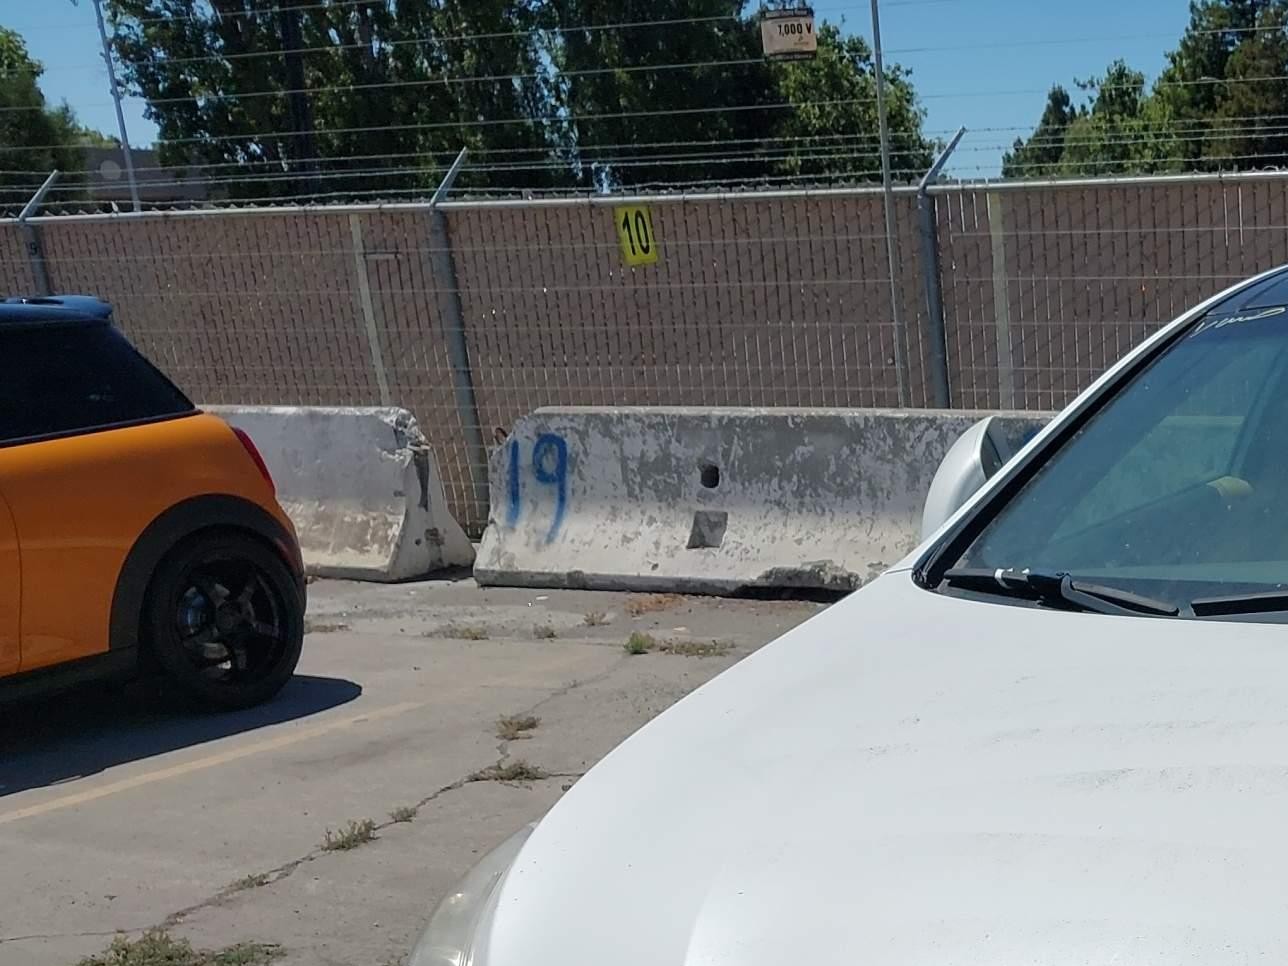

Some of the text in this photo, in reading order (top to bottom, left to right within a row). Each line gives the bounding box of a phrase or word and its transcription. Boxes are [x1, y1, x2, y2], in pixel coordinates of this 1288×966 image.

[805, 23, 812, 34] V
[622, 210, 650, 255] 10
[505, 433, 568, 544] 19
